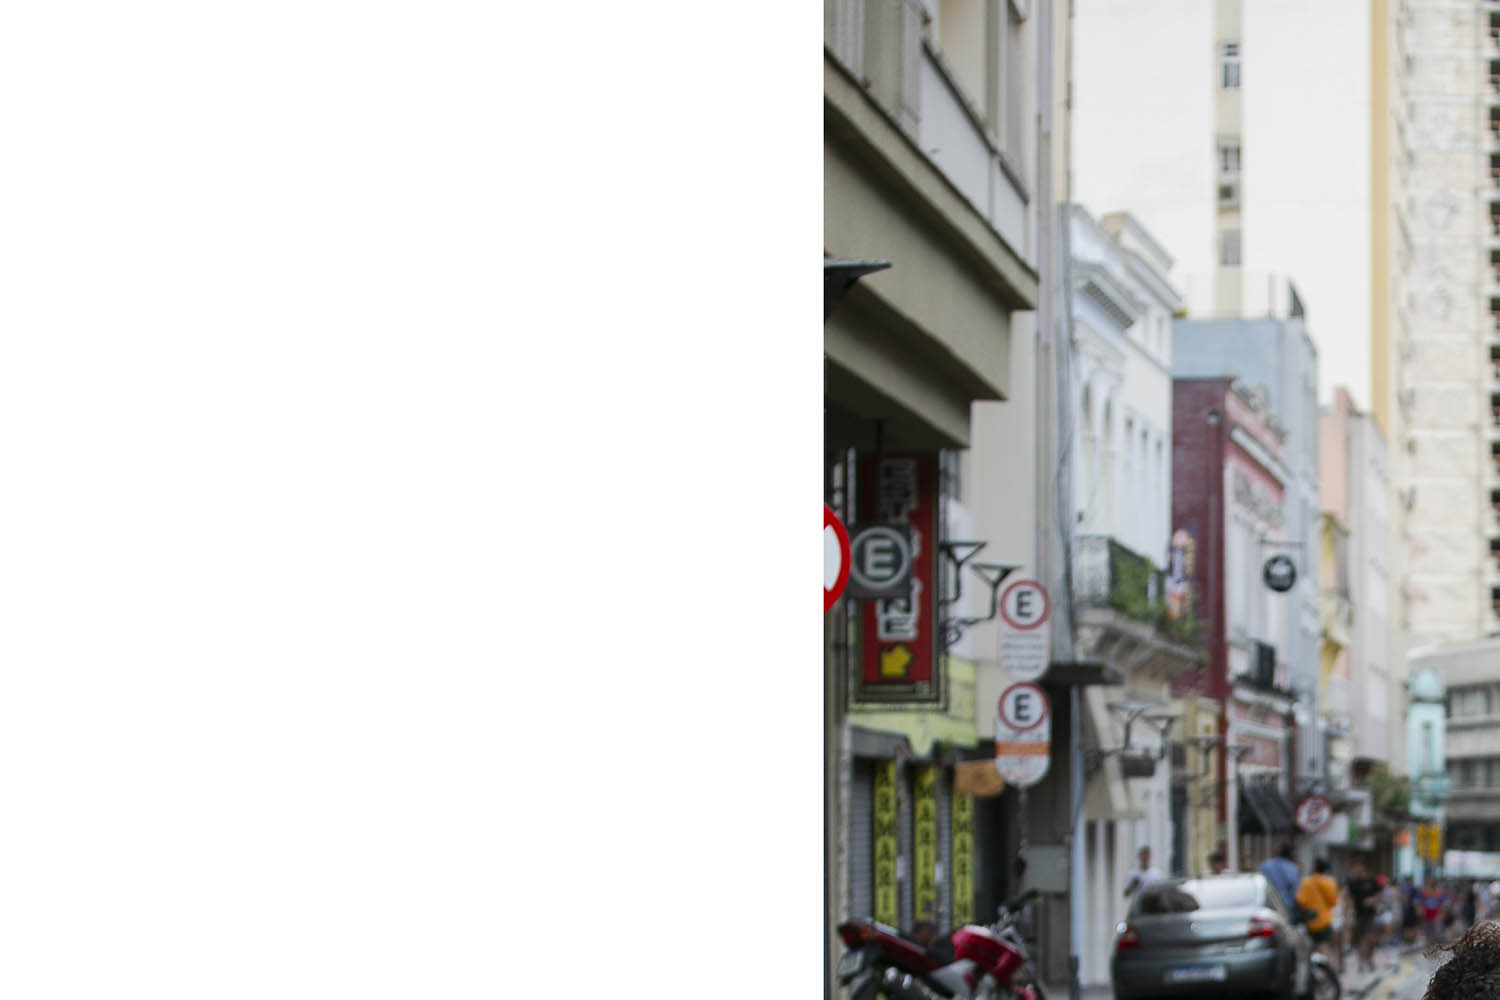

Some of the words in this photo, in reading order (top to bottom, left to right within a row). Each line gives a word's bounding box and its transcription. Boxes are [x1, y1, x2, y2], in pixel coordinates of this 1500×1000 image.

[865, 538, 895, 576] E
[1016, 591, 1032, 617] E
[1014, 694, 1030, 721] E
[876, 763, 895, 927] ARMARI
